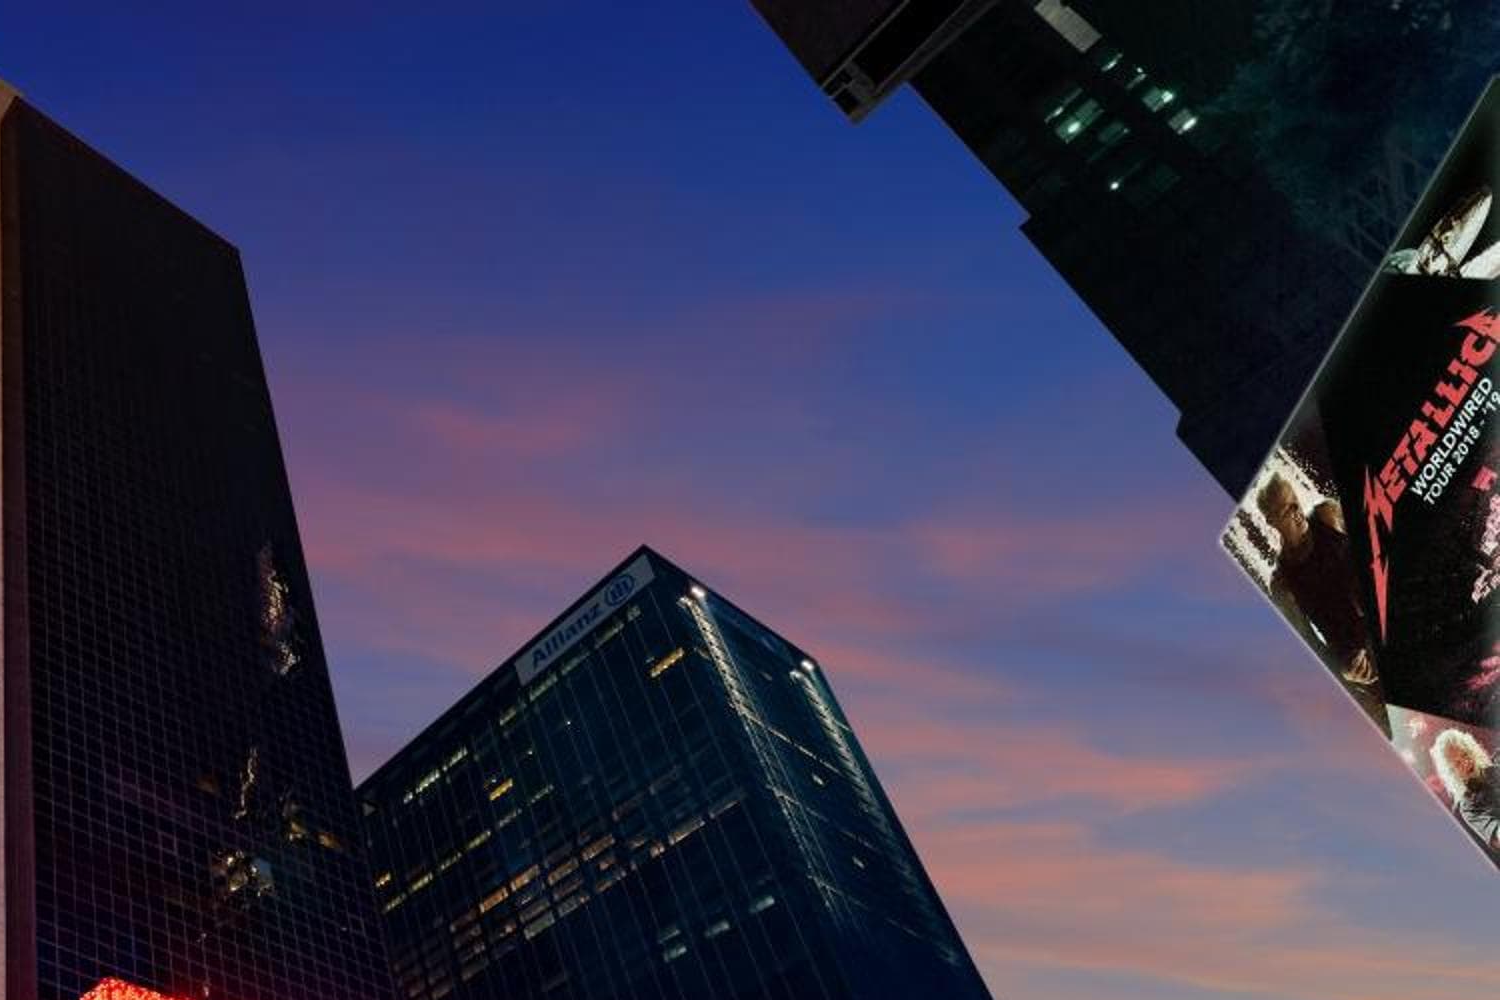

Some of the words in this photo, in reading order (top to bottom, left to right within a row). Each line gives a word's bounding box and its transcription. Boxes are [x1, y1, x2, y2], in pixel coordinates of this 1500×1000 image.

[1410, 377, 1493, 496] WORLDWIRED
[1423, 462, 1457, 505] TOUR
[1451, 425, 1481, 465] 2018
[532, 603, 604, 670] Allianz
